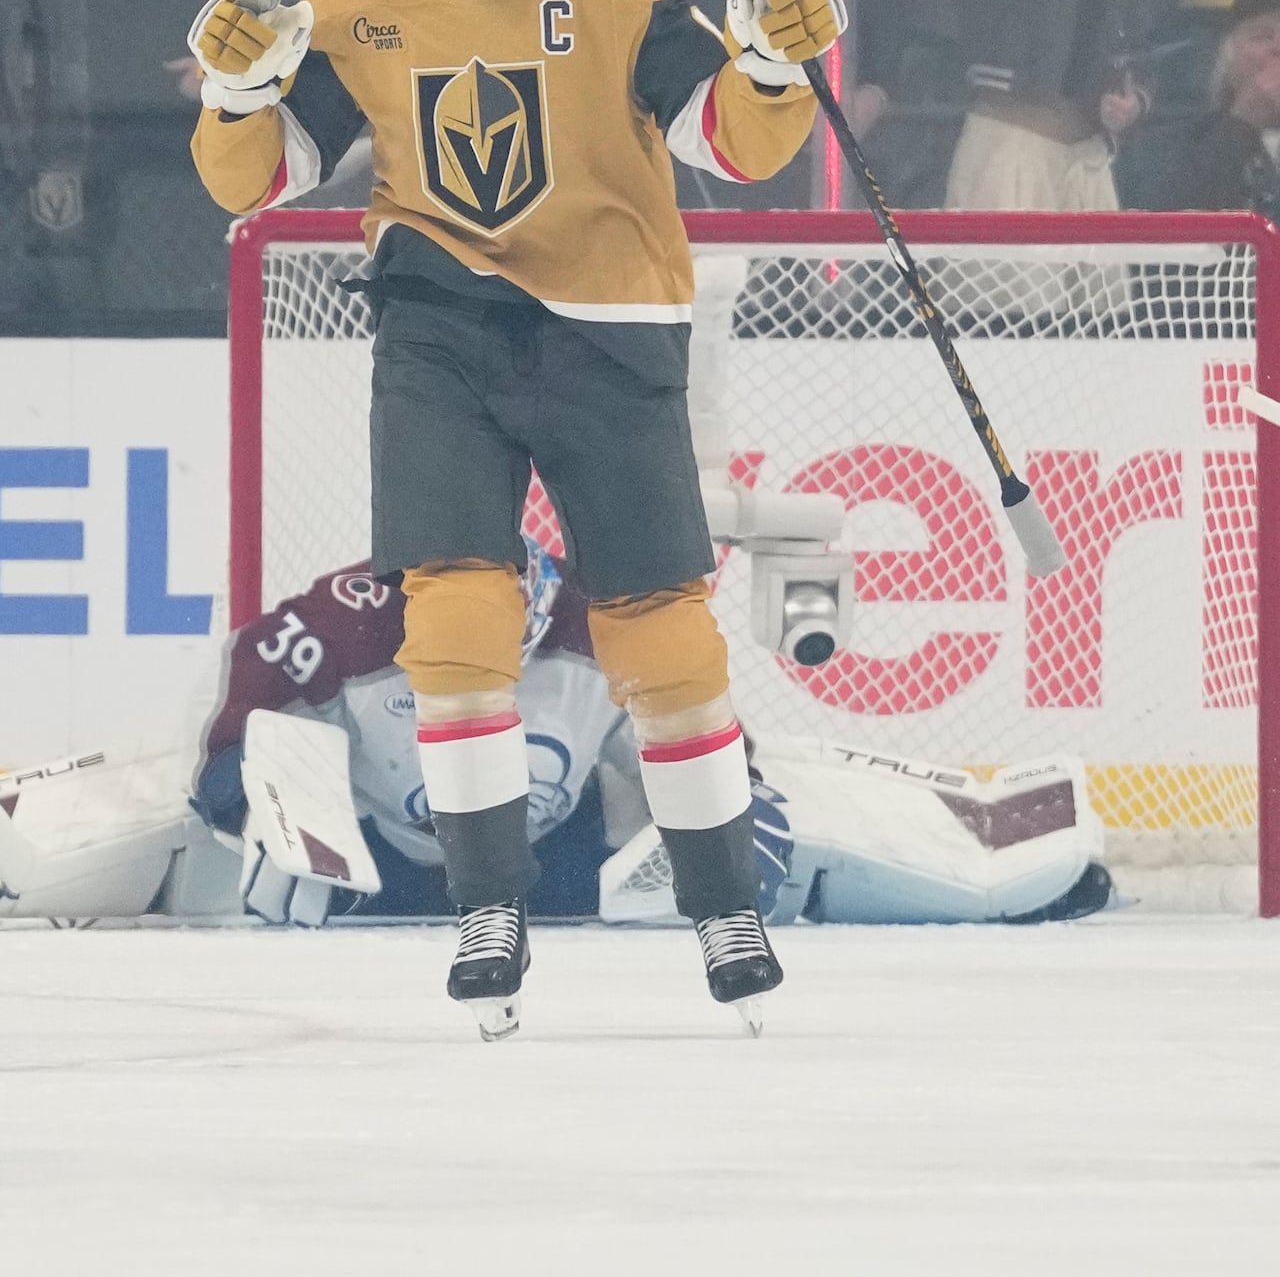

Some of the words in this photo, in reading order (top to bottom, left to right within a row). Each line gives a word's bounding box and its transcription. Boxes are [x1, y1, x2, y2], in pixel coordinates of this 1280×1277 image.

[353, 17, 401, 45] Circa
[373, 36, 404, 51] SPORTS
[256, 611, 324, 685] 39
[833, 747, 969, 790] TRUE
[264, 780, 296, 851] TRUE
